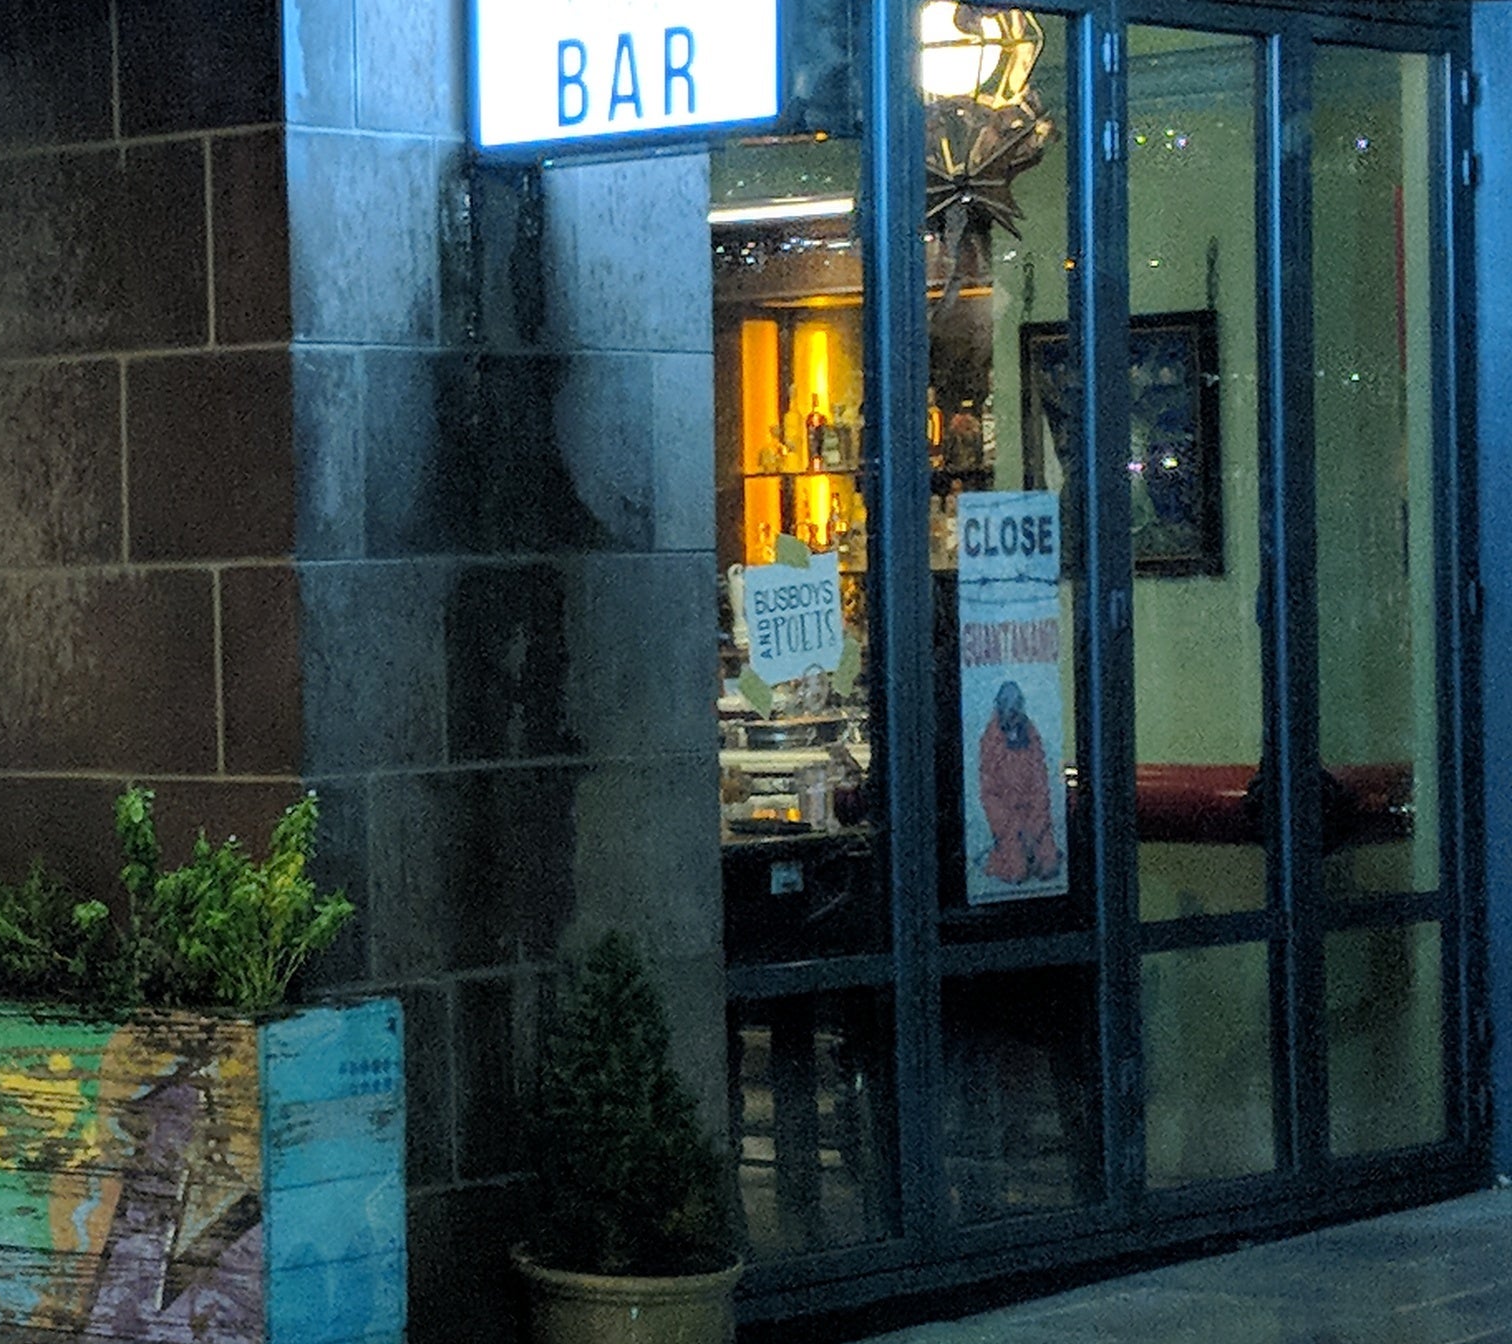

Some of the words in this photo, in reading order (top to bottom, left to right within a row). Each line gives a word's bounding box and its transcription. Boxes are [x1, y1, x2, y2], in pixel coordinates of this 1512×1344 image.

[556, 23, 700, 130] BAR
[964, 515, 1054, 558] CLOSE
[754, 579, 834, 616] BUSBOYS
[757, 619, 773, 660] AND
[772, 608, 837, 657] POETS
